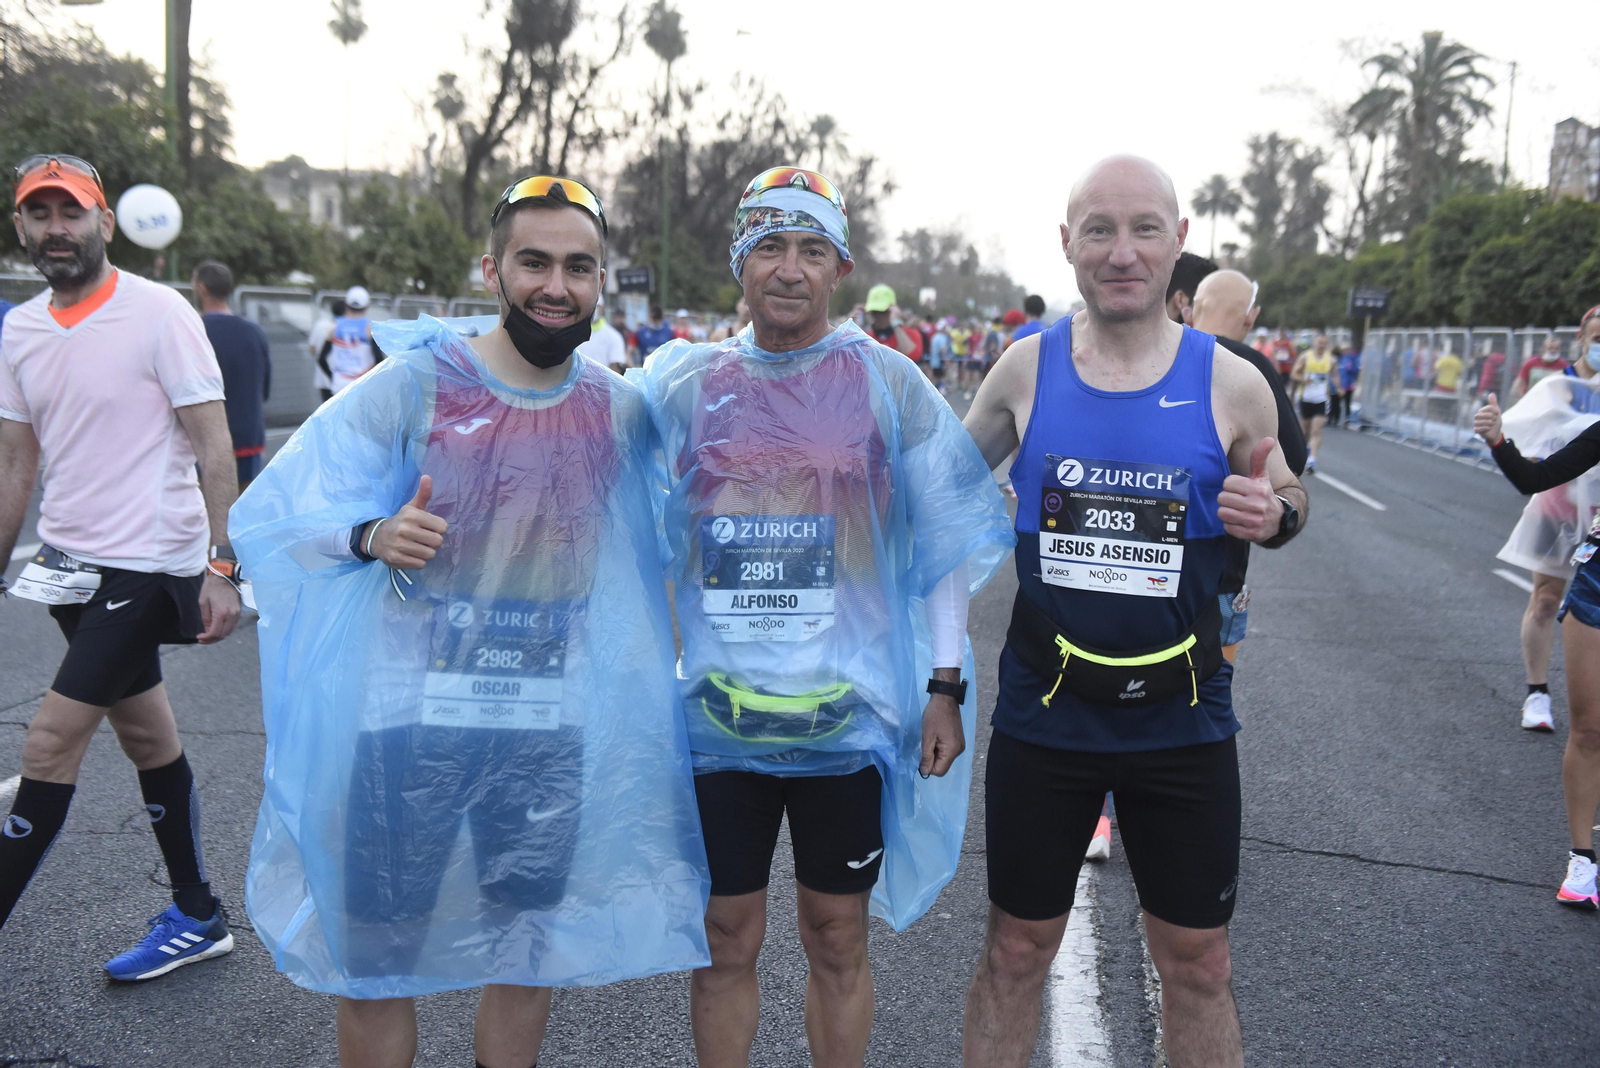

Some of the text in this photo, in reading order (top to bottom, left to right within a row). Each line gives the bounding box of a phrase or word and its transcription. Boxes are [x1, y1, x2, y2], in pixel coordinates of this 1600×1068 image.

[1088, 467, 1173, 491] ZURICH
[1123, 496, 1143, 505] SEVILLA
[1143, 498, 1157, 506] 2022
[1084, 508, 1136, 531] 2033
[739, 522, 817, 538] ZURICH
[1048, 538, 1171, 565] JESUS ASENSIO
[740, 561, 784, 581] 2981
[730, 594, 798, 609] ALFONSO
[476, 647, 523, 669] 2982
[471, 680, 521, 697] OSCAR
